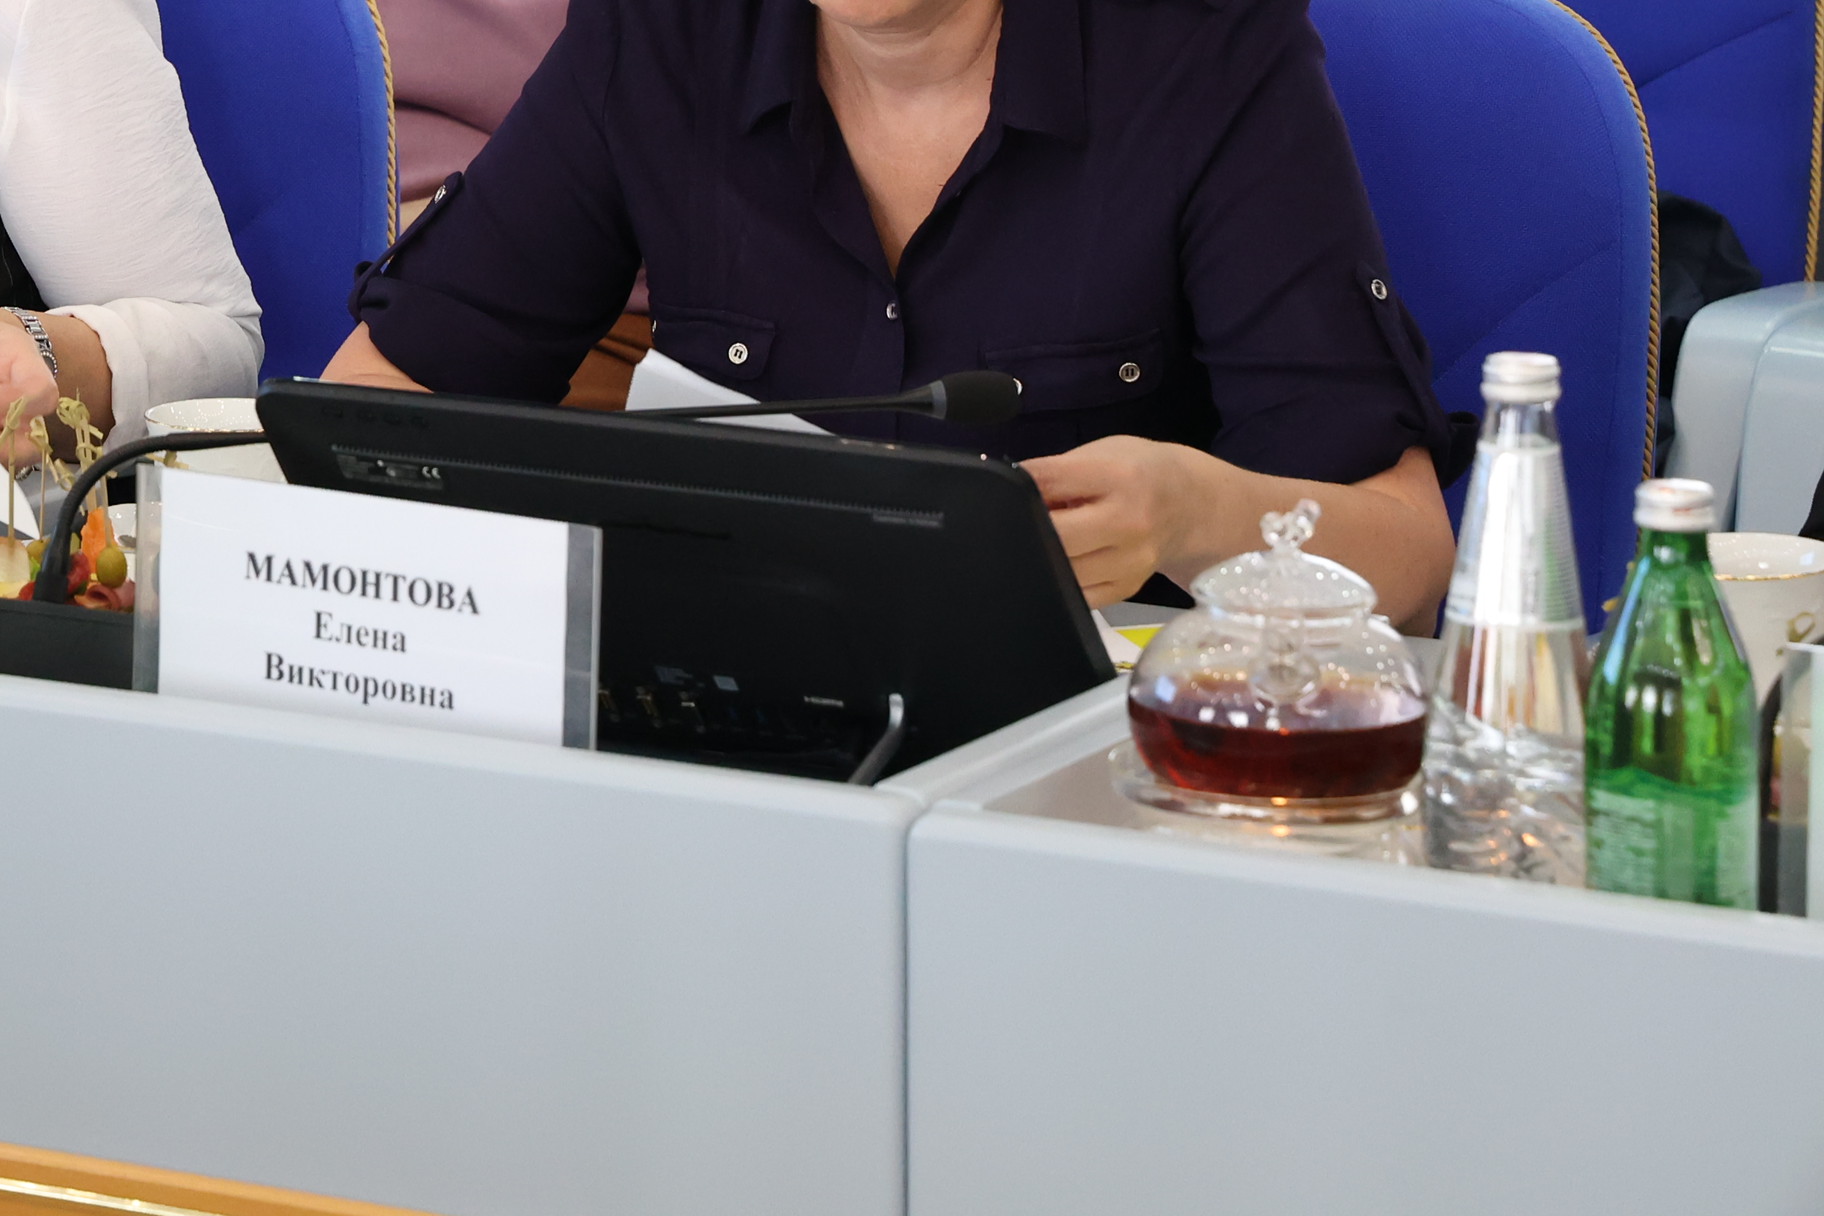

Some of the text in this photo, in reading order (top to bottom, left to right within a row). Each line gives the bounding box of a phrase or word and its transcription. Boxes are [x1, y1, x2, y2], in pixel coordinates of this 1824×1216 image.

[245, 551, 480, 615] МАМОНТОВА
[314, 609, 407, 653] Елена
[265, 651, 454, 710] Викторовна
